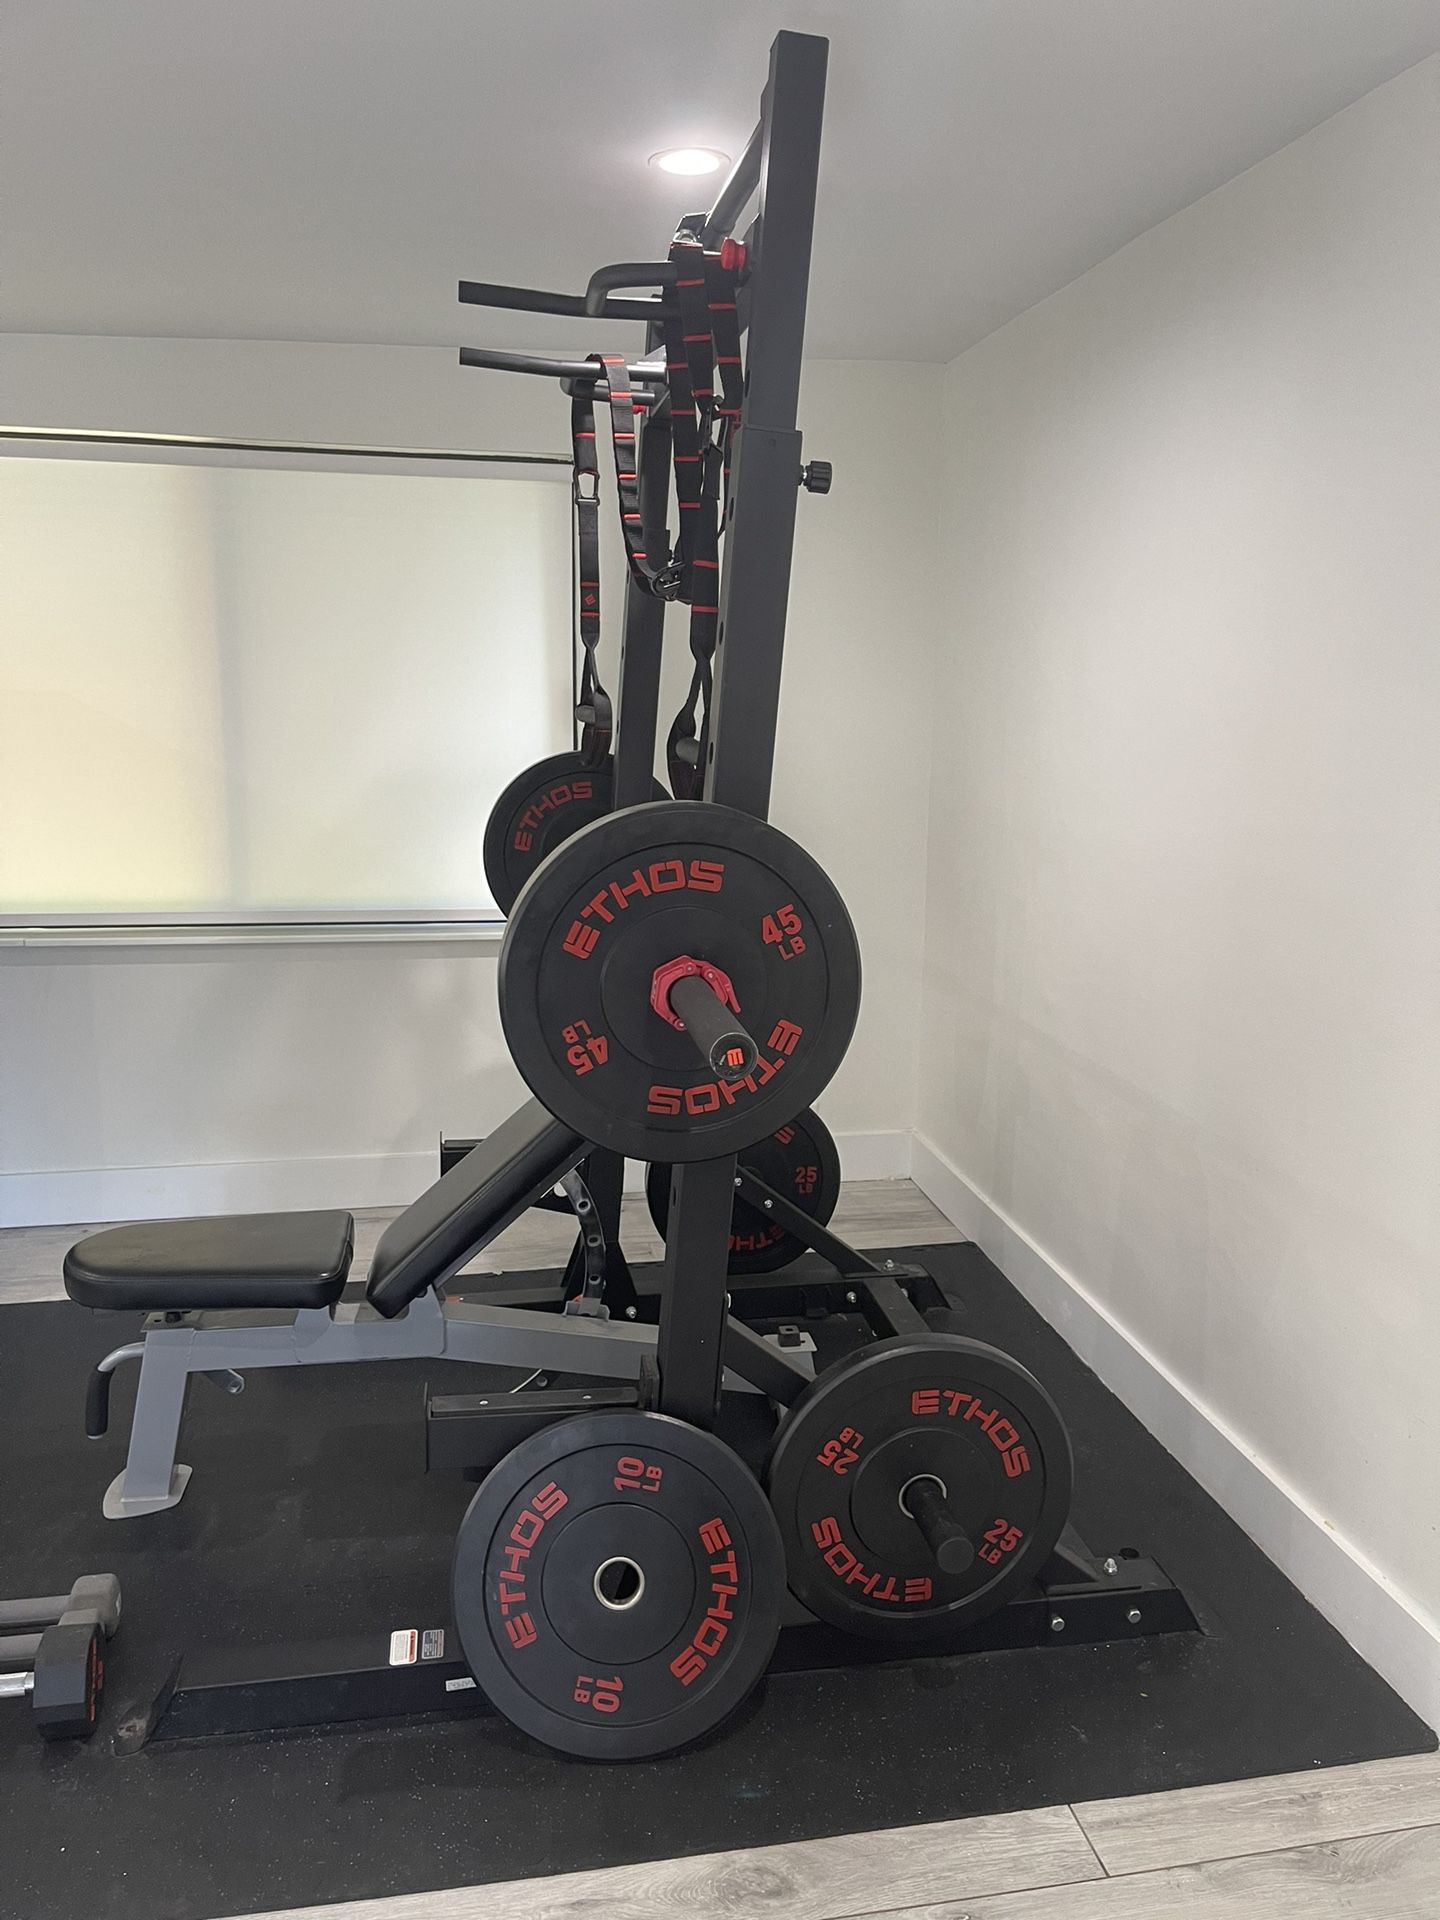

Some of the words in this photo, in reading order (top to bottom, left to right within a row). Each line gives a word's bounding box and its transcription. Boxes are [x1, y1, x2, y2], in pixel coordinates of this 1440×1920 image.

[514, 780, 594, 852] ETHOS
[562, 859, 725, 960] ETHOS
[761, 903, 803, 946] 45
[778, 936, 807, 961] LB
[561, 1019, 593, 1044] LB
[564, 1035, 609, 1076] 45
[647, 1018, 804, 1116] ETHOS
[794, 1166, 818, 1184] 25
[839, 1426, 864, 1450] LB
[911, 1388, 1031, 1478] ETHOS
[613, 1456, 645, 1492] 10
[816, 1439, 861, 1476] 25
[642, 1465, 664, 1493] LB
[978, 1543, 1003, 1565] LB
[983, 1518, 1024, 1553] 25
[499, 1481, 569, 1649] ETHOS
[810, 1516, 934, 1603] ETHOS
[669, 1516, 739, 1687] ETHOS
[573, 1675, 593, 1704] LB
[592, 1676, 624, 1713] 10
